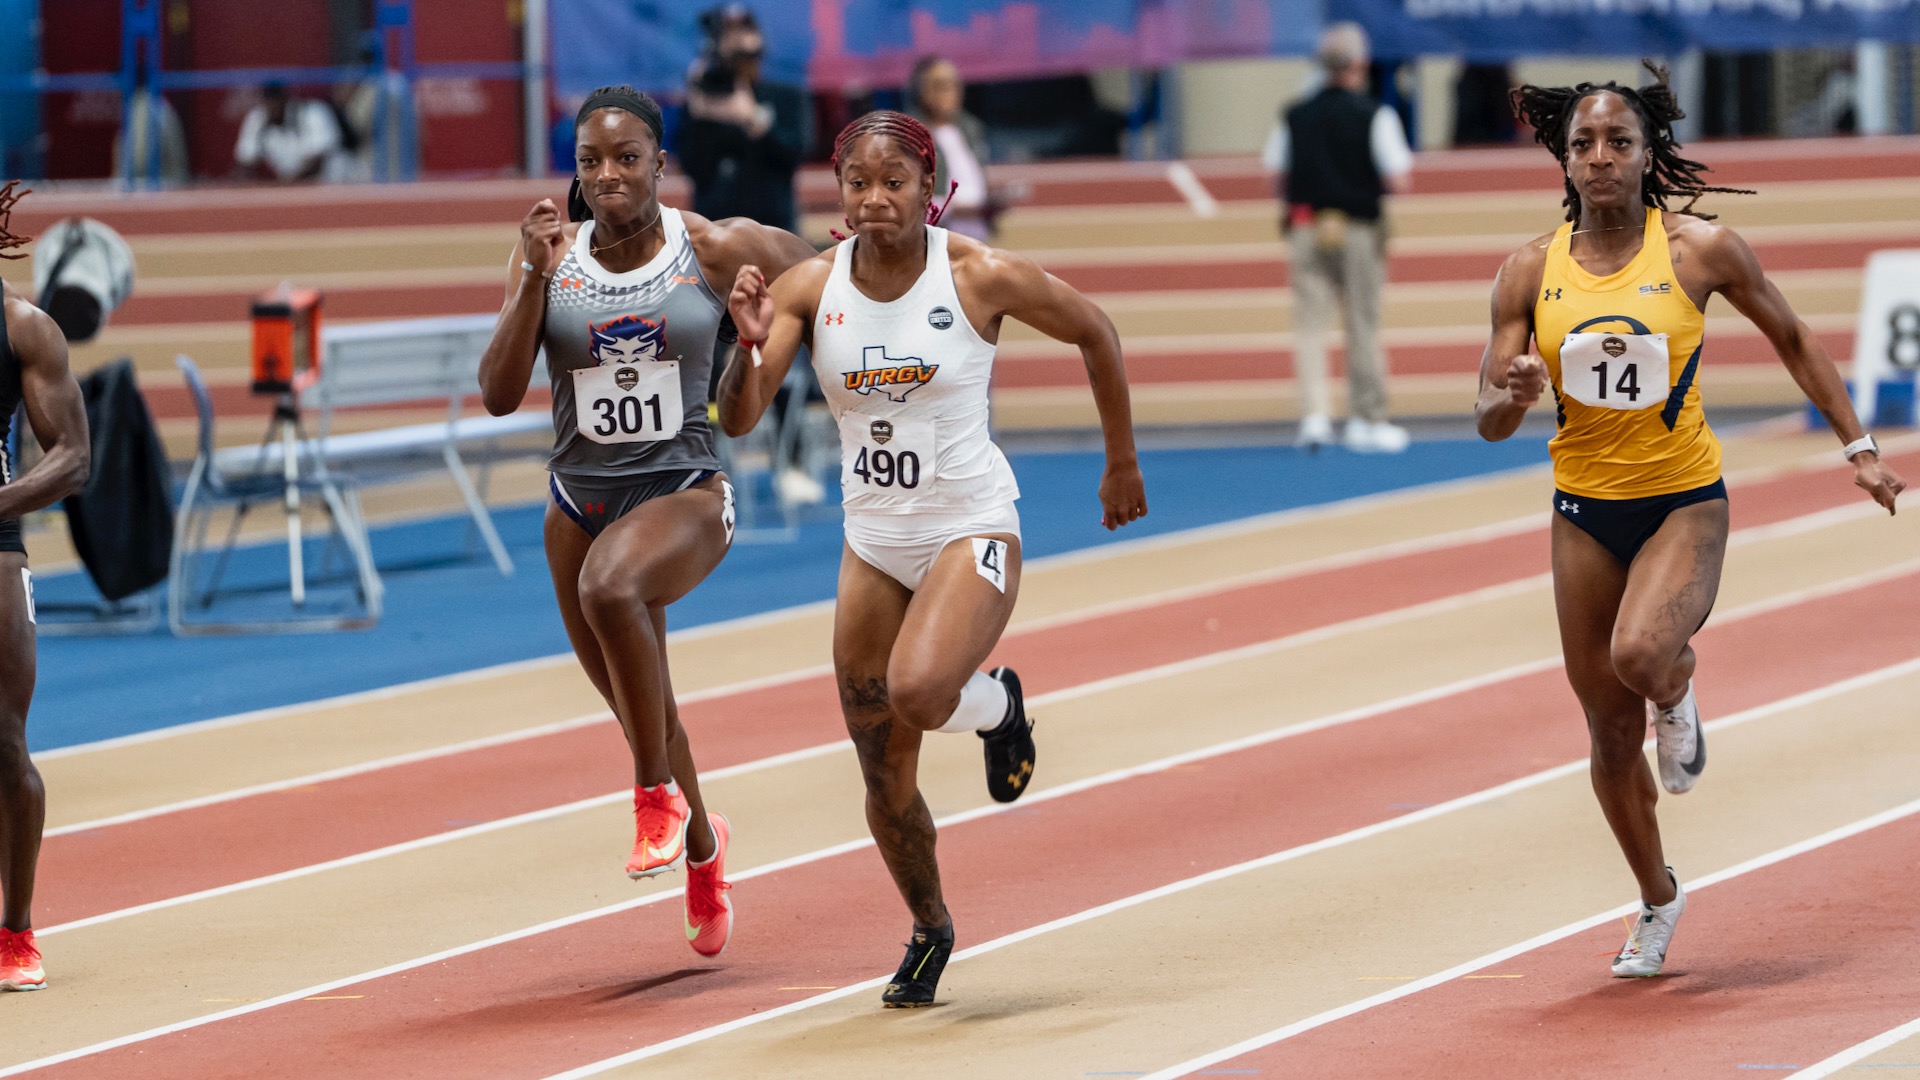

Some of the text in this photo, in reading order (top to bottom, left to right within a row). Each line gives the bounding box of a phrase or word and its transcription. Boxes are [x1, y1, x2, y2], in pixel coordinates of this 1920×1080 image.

[1639, 283, 1671, 292] SLC
[1886, 303, 1920, 369] 8
[841, 364, 940, 391] UTRGV
[1591, 361, 1641, 402] 14
[592, 393, 663, 437] 301
[853, 446, 921, 490] 490
[981, 540, 1002, 576] 4
